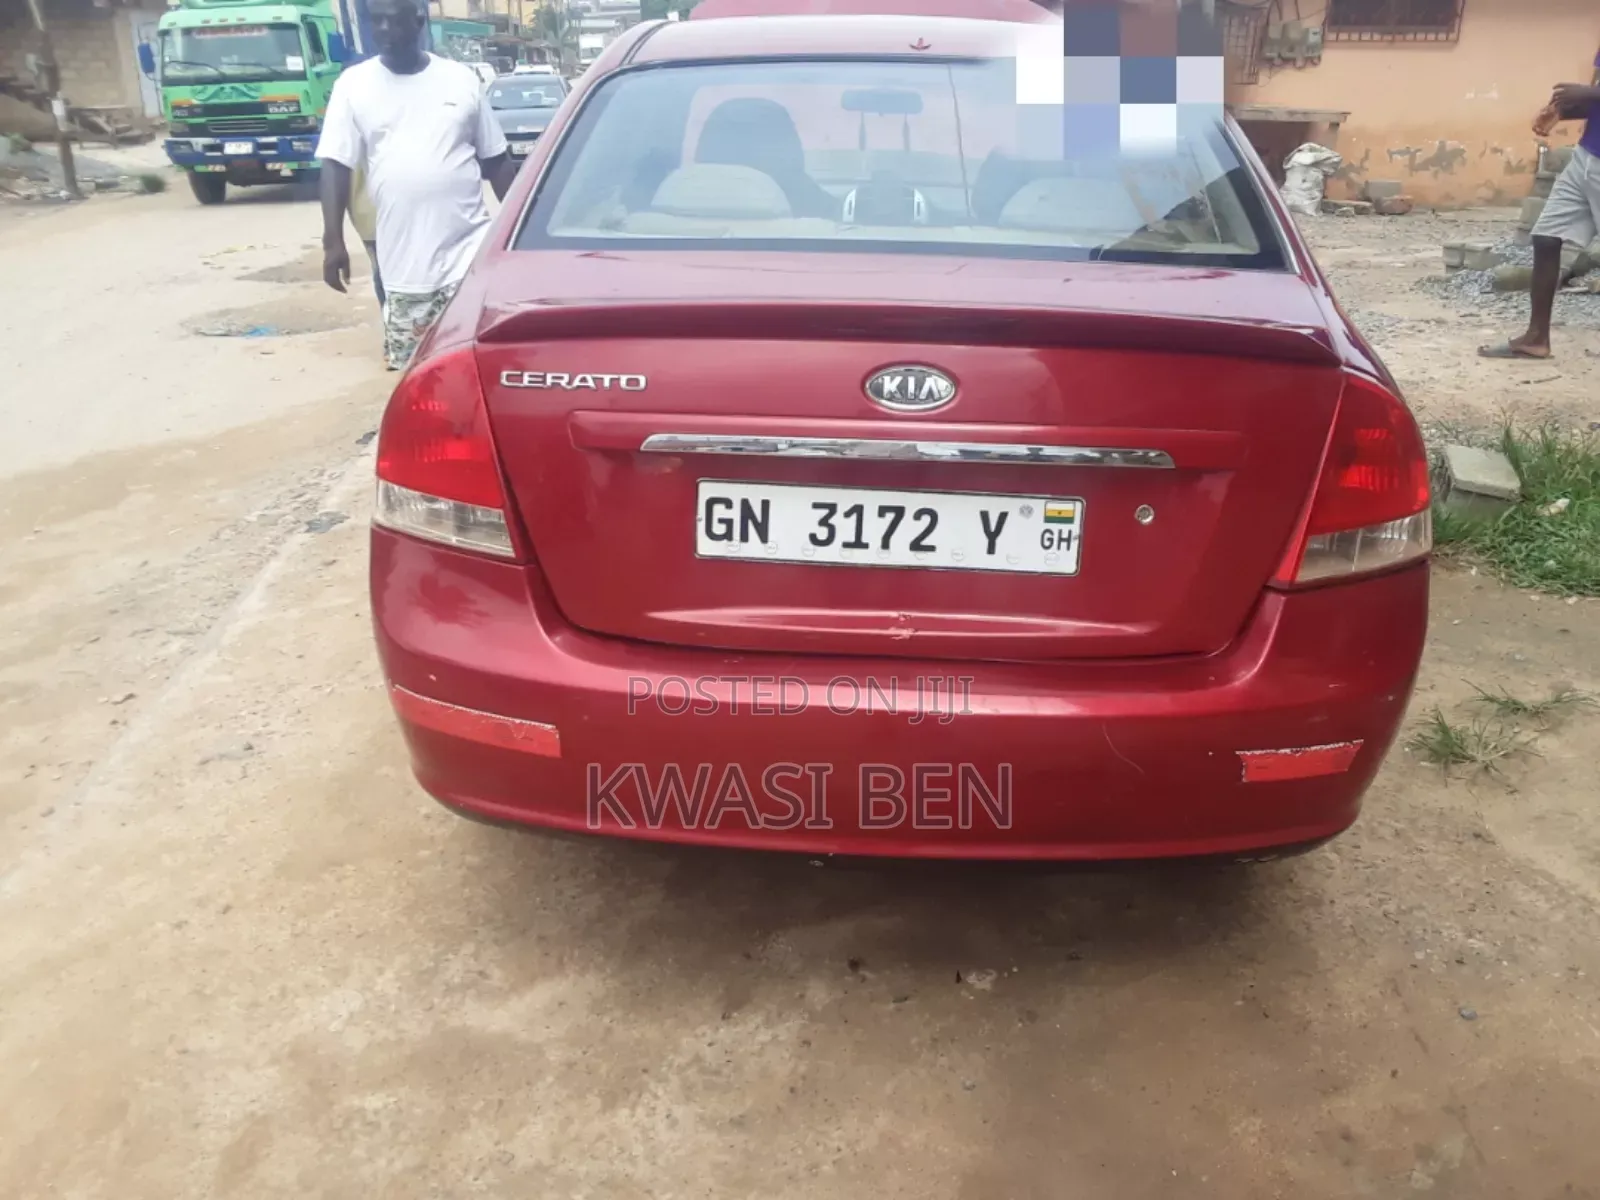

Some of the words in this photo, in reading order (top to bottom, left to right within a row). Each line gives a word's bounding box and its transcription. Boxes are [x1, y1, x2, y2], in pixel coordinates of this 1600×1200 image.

[499, 370, 648, 391] CERATO
[880, 376, 943, 402] KIA
[704, 496, 770, 544] GN
[808, 502, 939, 552] 3172
[979, 510, 1008, 555] Y
[1040, 529, 1072, 551] GH
